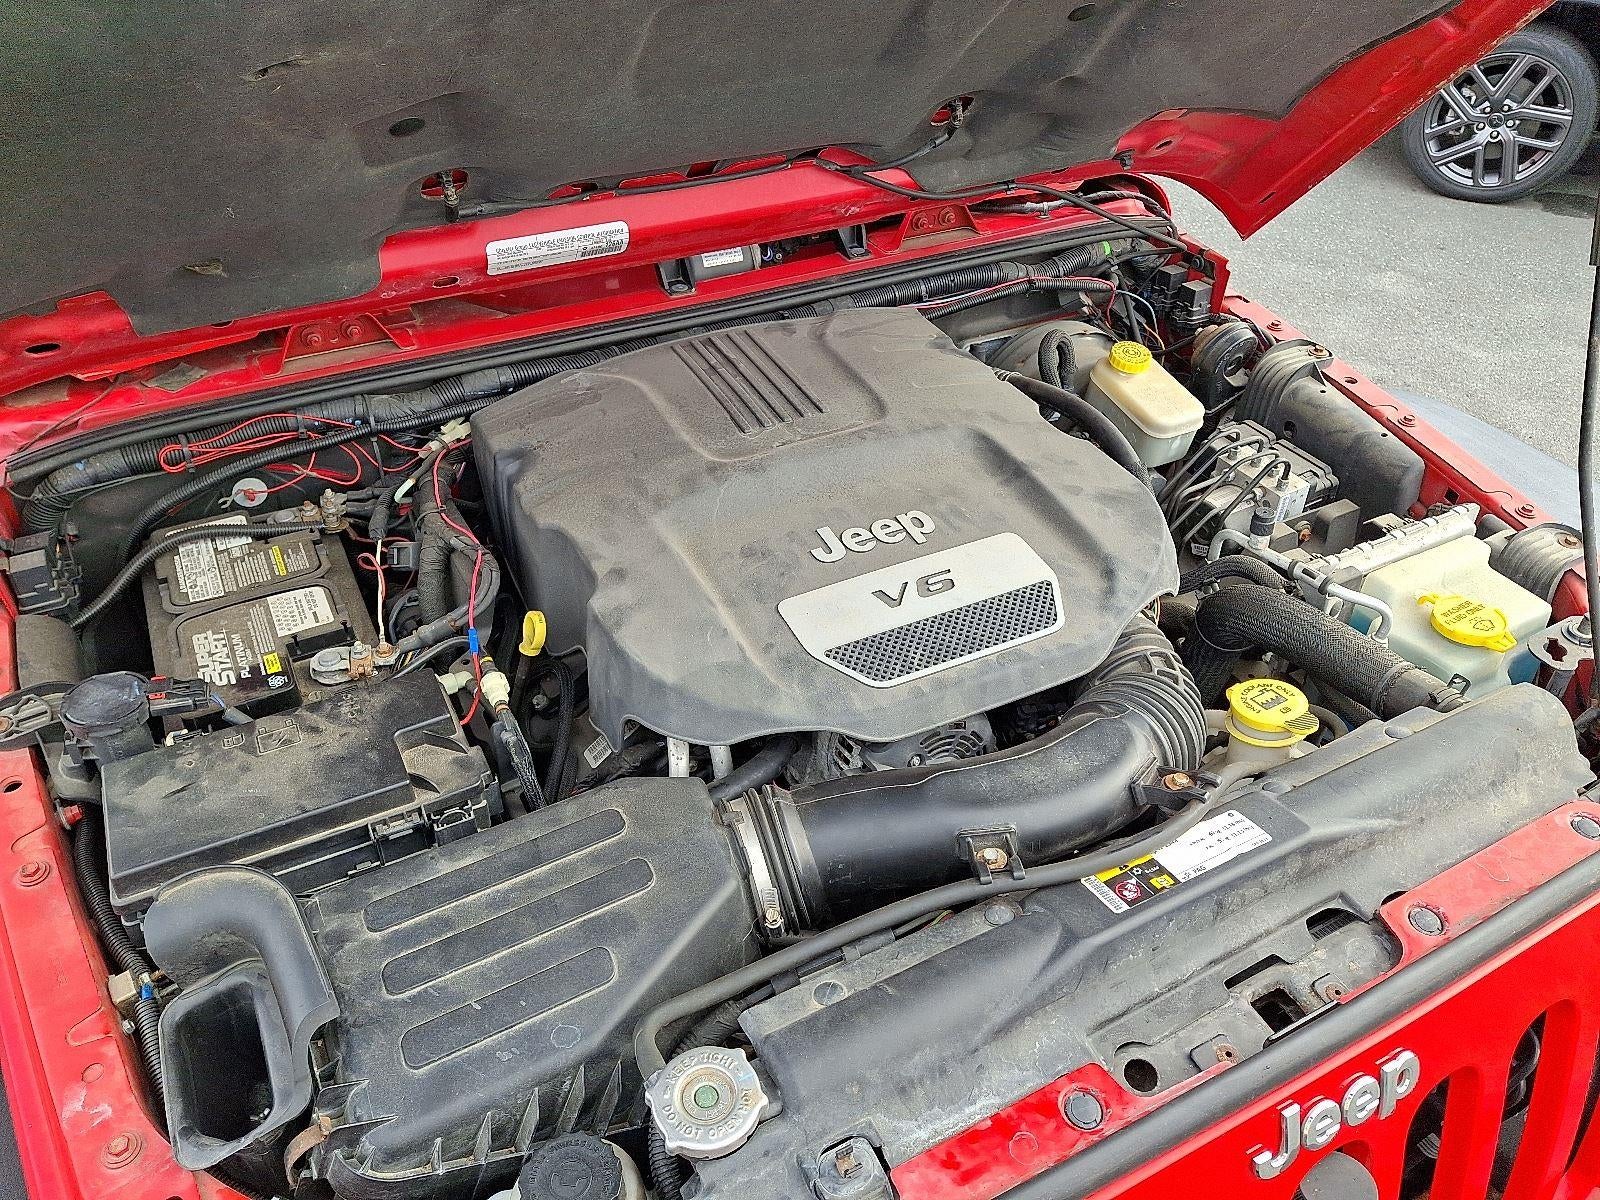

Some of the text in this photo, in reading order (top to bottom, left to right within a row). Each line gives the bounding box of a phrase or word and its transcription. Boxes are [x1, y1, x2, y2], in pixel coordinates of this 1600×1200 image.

[809, 509, 936, 563] Jeep
[871, 568, 955, 609] V6
[1440, 600, 1473, 617] WASHER
[192, 632, 214, 684] SUPER
[206, 629, 237, 686] START
[231, 633, 252, 678] PLATINUM
[1240, 683, 1274, 696] COOLANT
[1275, 685, 1295, 697] ONLY
[666, 1052, 737, 1083] KEEP TIGHT
[662, 1104, 677, 1121] DO
[675, 1121, 703, 1139] NOT
[708, 1113, 744, 1139] OPEN
[739, 1087, 753, 1114] HOT
[1252, 1049, 1421, 1180] Jeep
